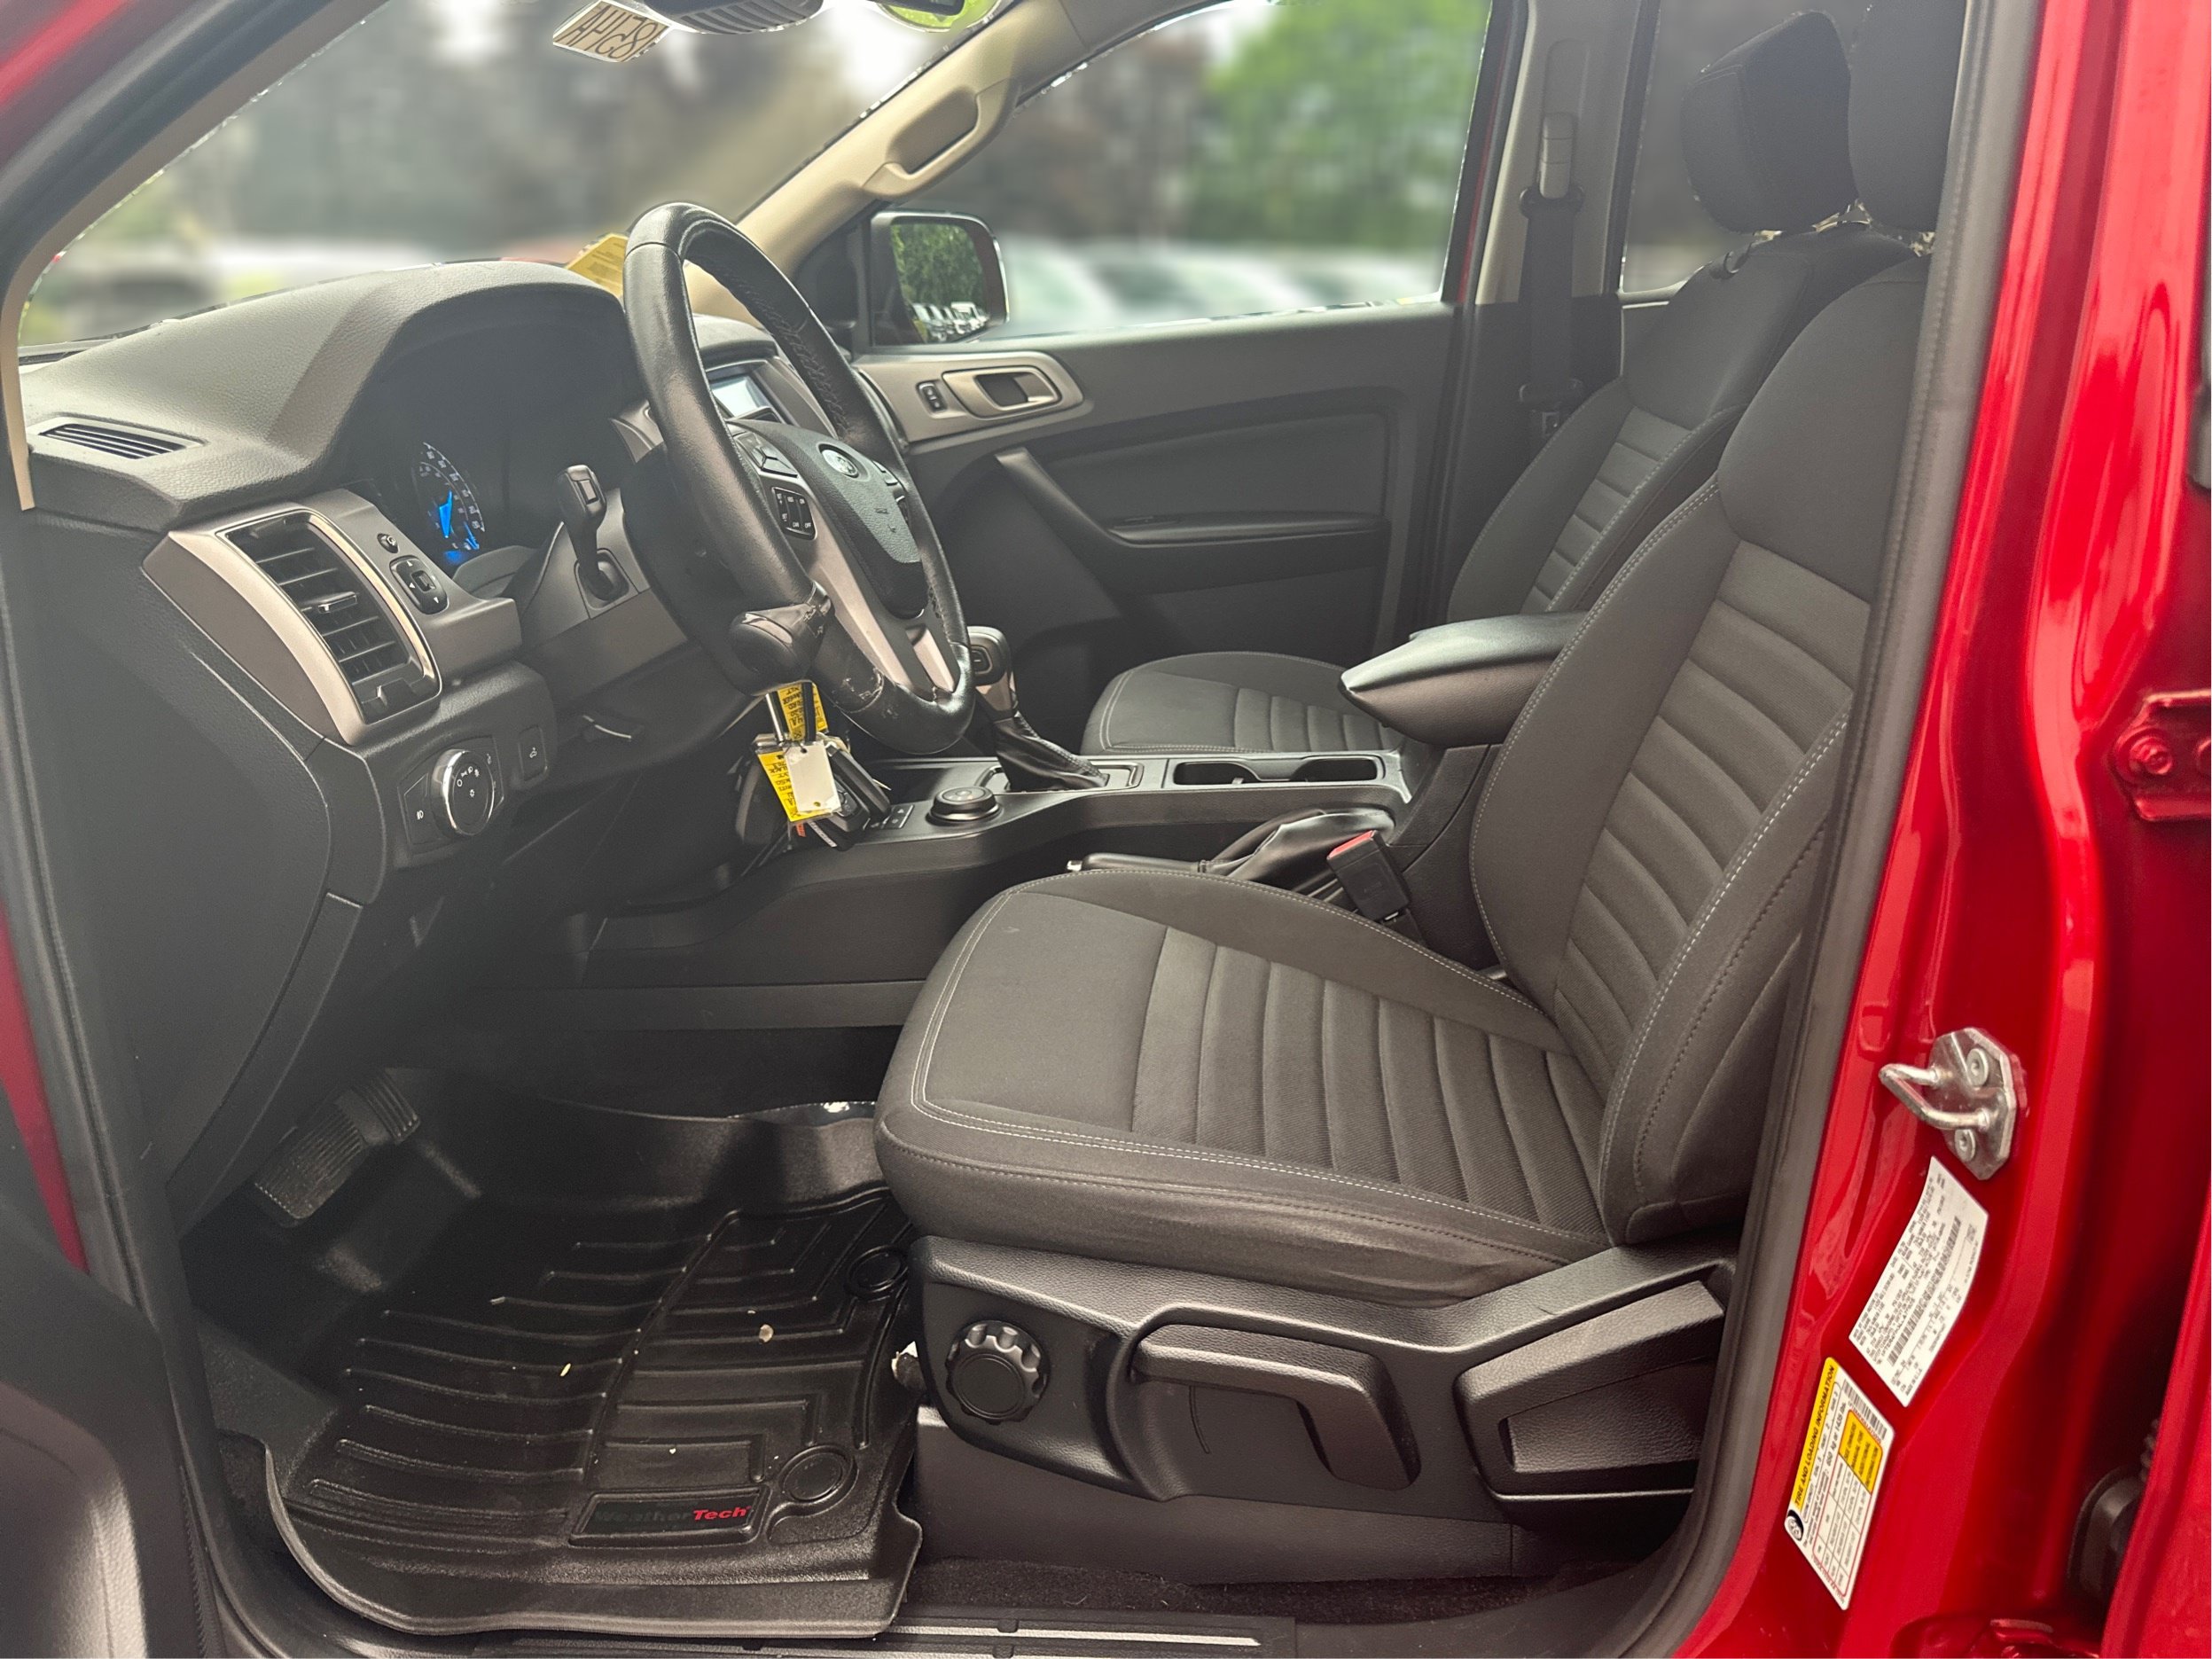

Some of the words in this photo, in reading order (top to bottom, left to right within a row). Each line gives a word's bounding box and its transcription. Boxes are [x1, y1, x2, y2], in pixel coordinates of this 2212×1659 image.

[1794, 1486, 1803, 1506] TIRE
[1805, 1427, 1817, 1466] LOADING
[1816, 1365, 1834, 1427] INFORMATION
